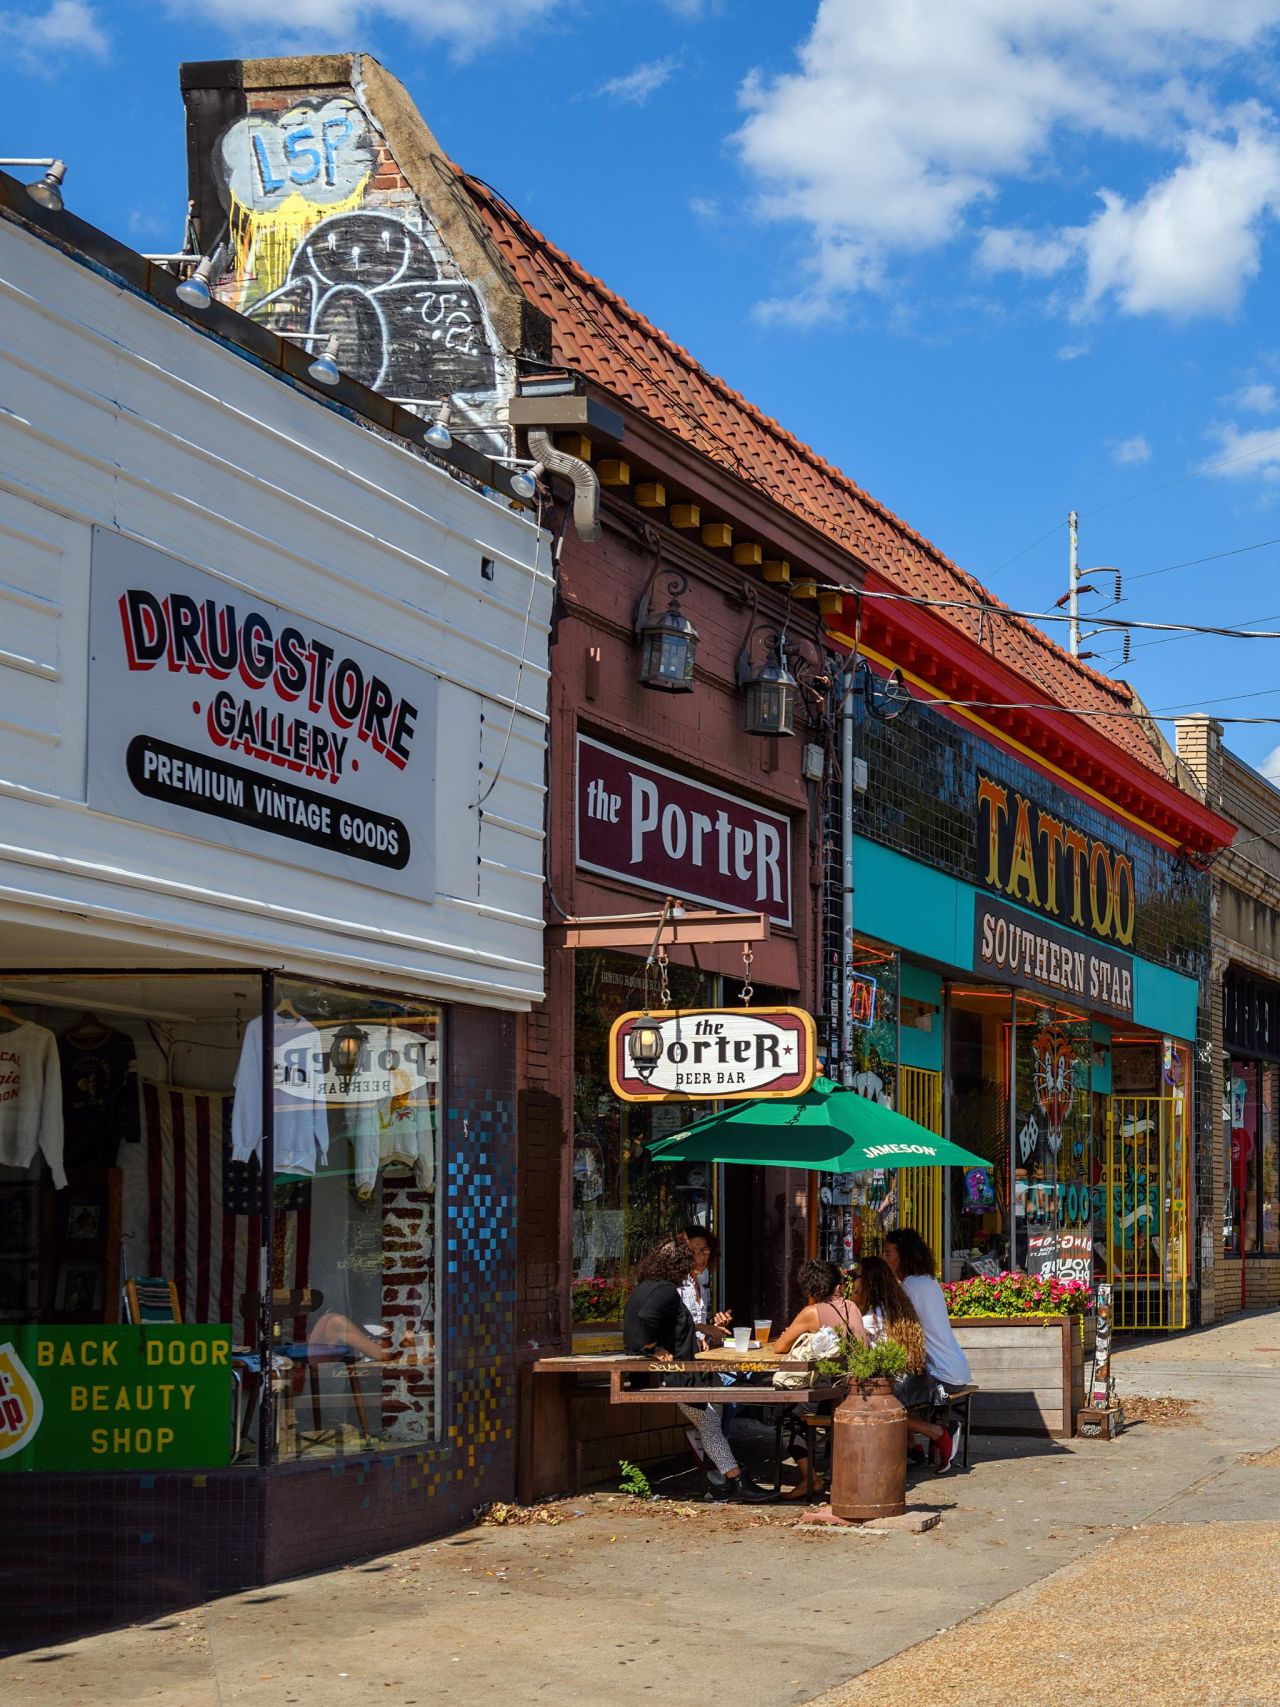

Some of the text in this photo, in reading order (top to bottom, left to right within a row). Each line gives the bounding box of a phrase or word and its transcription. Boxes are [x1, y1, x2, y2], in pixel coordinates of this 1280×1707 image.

[252, 117, 352, 196] L5P
[118, 589, 418, 771] DRUGSTORE
[207, 690, 348, 784] GALLERY
[143, 749, 399, 856] PREMIUM VINTAGE GOODS
[587, 779, 622, 824] the
[977, 774, 1135, 947] TATTOO
[981, 912, 1132, 1010] SOUTHERN STAR
[695, 1019, 724, 1036] the
[666, 1032, 782, 1071] orteR
[676, 1072, 746, 1085] BEER BAR
[861, 1143, 936, 1159] JAMESON
[37, 1340, 229, 1366] BACK DOOR
[71, 1384, 196, 1411] BEAUTY
[91, 1427, 175, 1454] SHOP
